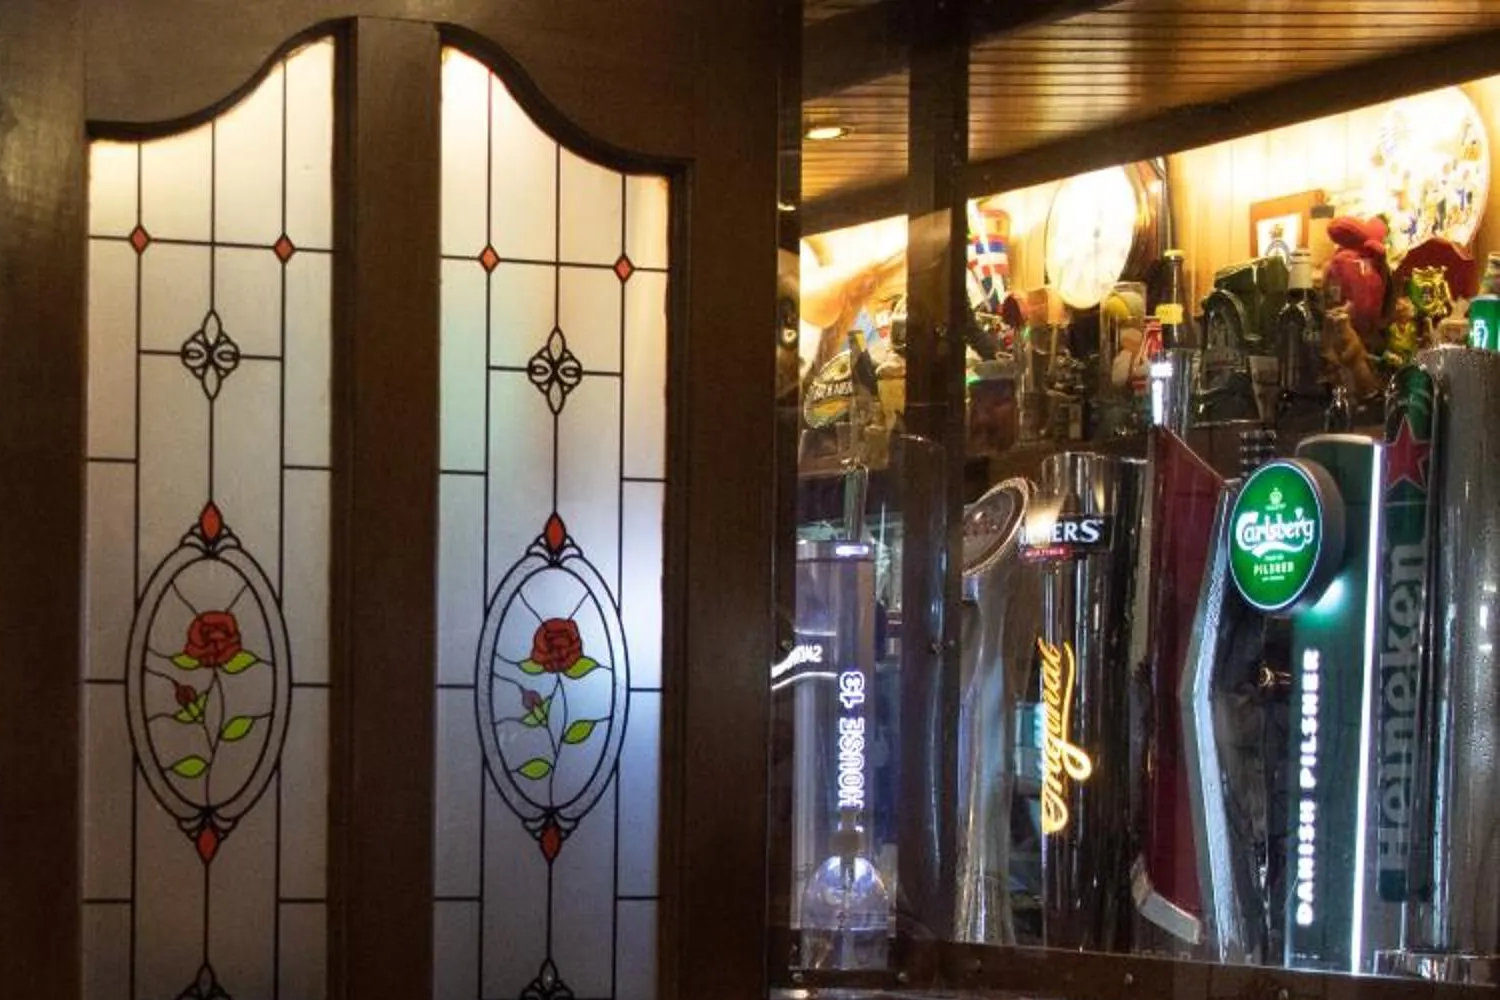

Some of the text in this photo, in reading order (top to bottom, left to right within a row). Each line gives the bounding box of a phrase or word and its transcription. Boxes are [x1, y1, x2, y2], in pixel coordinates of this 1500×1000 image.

[1235, 506, 1316, 553] Carlsberg
[839, 671, 865, 708] 13
[1378, 538, 1426, 872] Heineken
[838, 717, 865, 809] HOUSE
[1295, 648, 1320, 926] DANISH PILSNER
